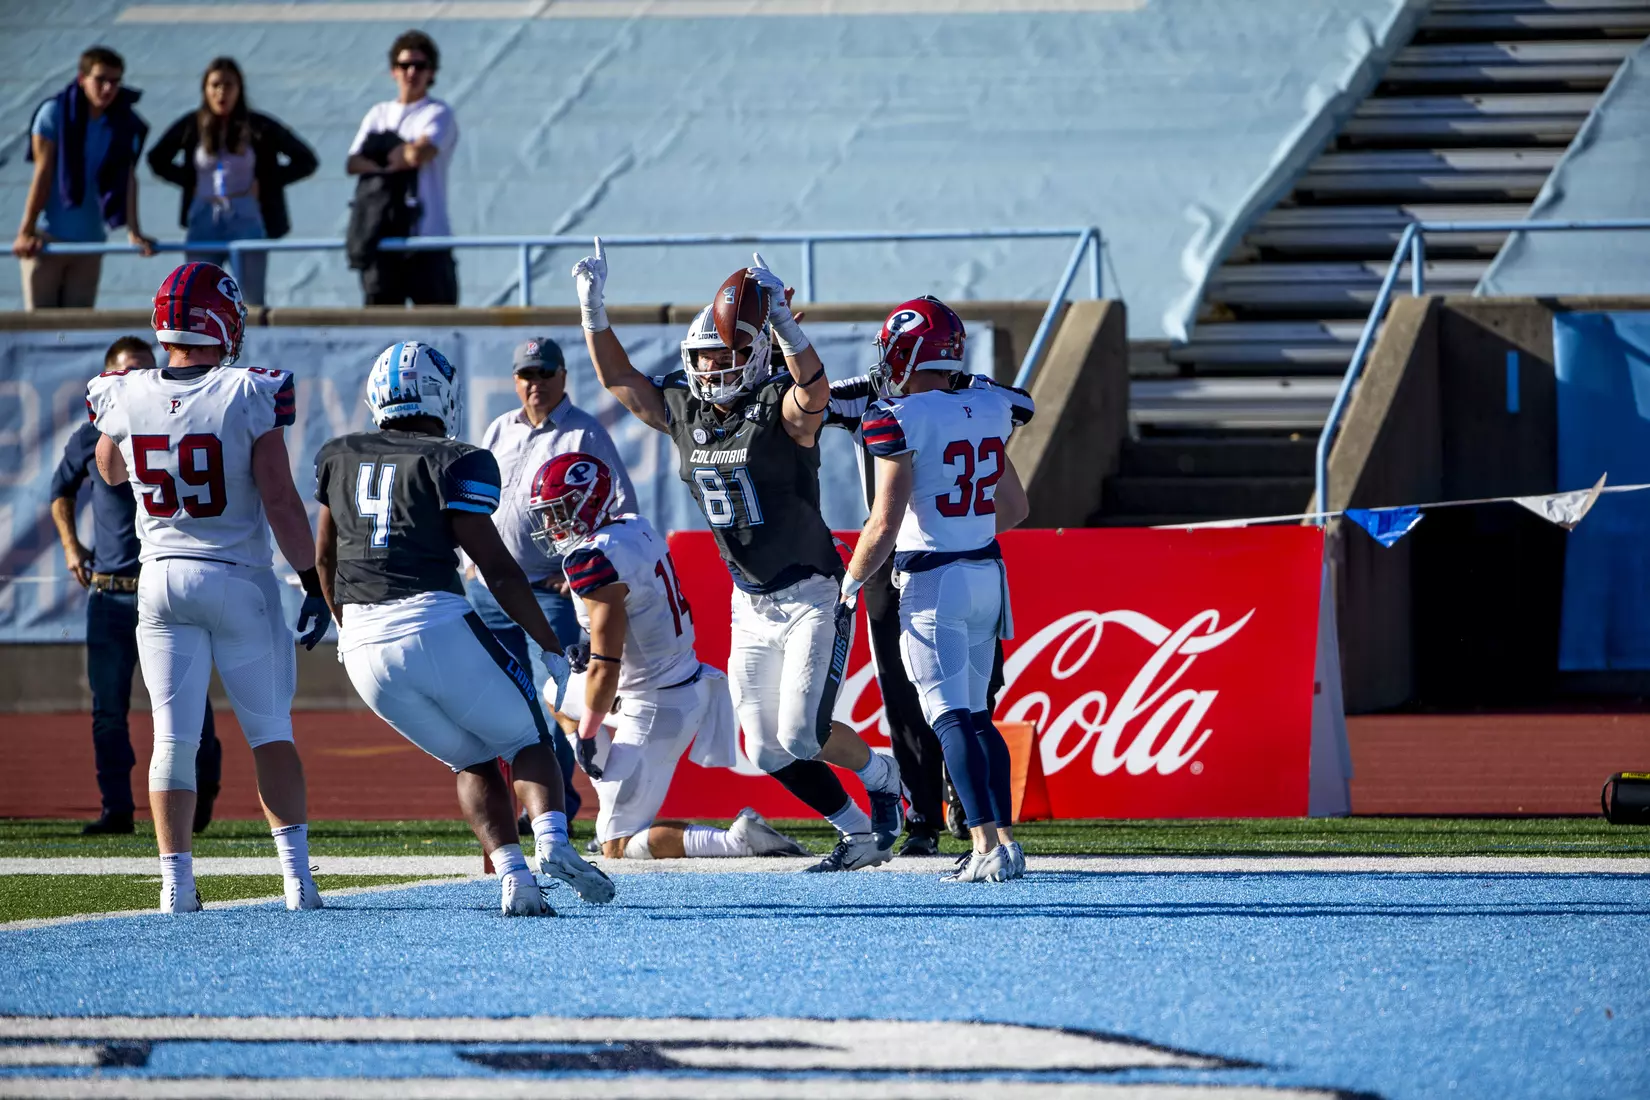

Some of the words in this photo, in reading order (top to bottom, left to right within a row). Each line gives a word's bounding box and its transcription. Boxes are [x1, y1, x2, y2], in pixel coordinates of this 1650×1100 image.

[891, 311, 917, 334] P
[169, 400, 182, 415] P
[131, 433, 228, 519] 59
[568, 462, 592, 484] P
[690, 448, 748, 464] COLUMBIA
[935, 436, 1006, 518] 32
[355, 463, 397, 548] 4
[692, 466, 765, 528] 81
[654, 551, 694, 638] 14
[506, 659, 537, 701] LIONS
[830, 635, 847, 685] LIONS
